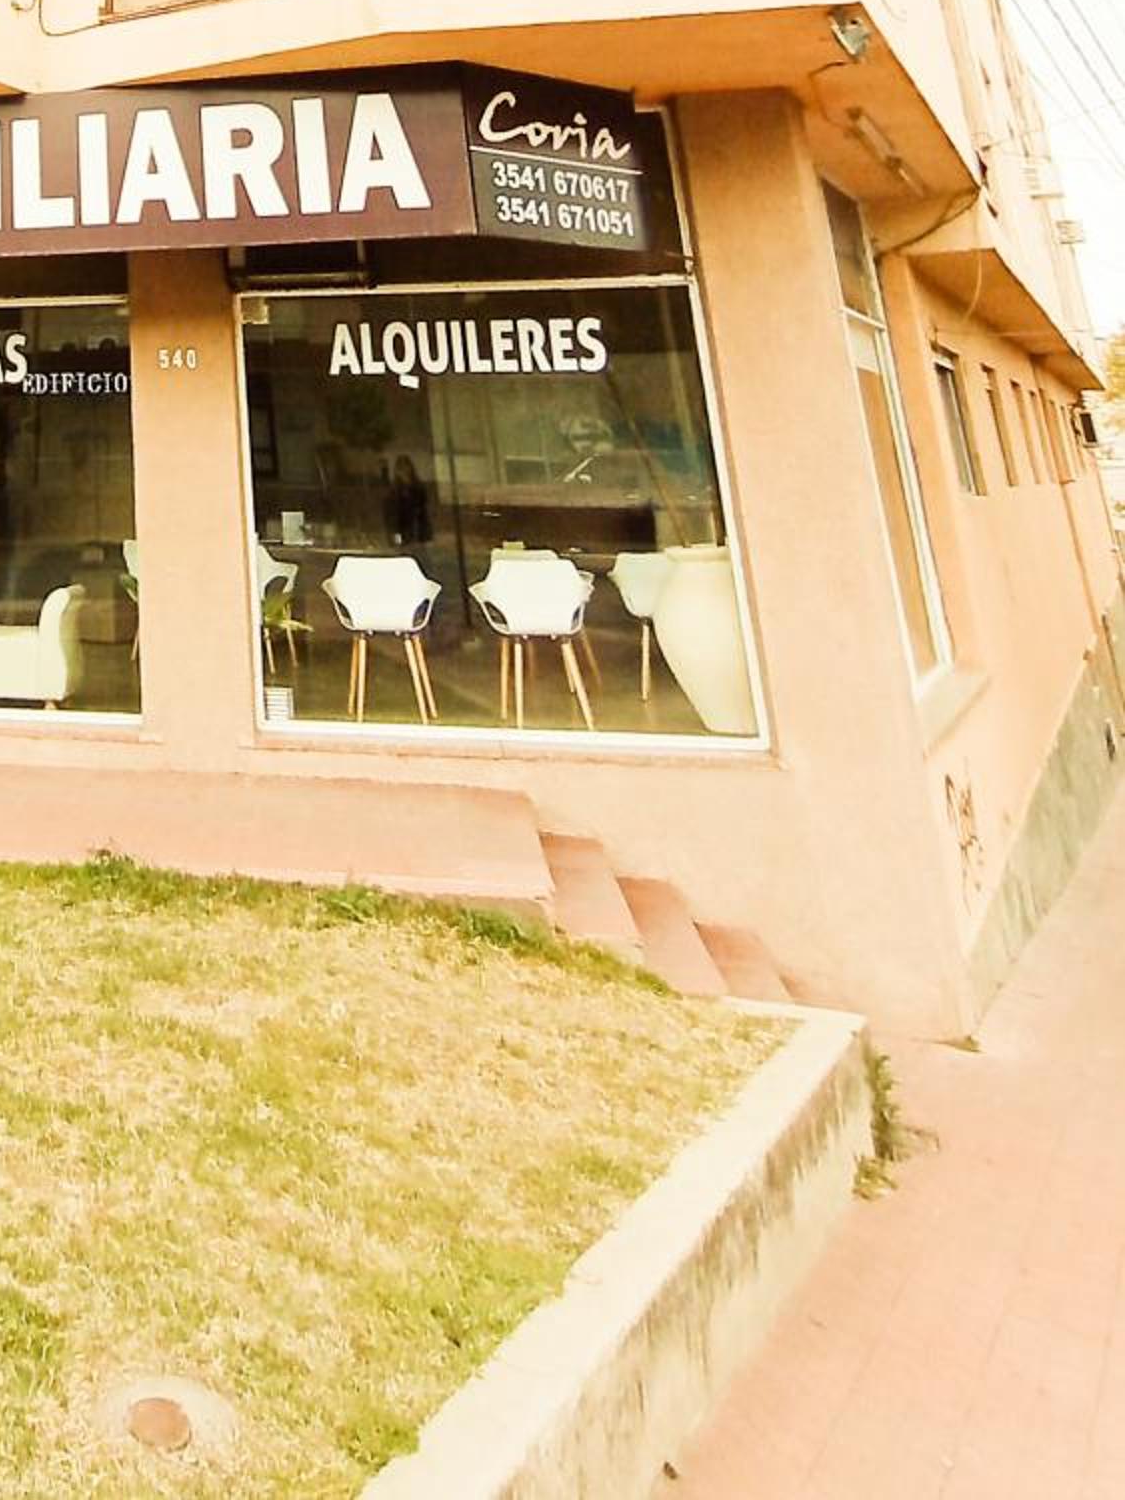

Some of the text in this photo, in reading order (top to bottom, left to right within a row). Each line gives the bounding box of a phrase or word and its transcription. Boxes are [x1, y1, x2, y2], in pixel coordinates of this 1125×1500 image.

[479, 91, 631, 160] Coria
[492, 161, 630, 204] 3541 670617
[496, 195, 635, 237] 3541 671051
[158, 348, 197, 370] 540
[329, 317, 607, 389] ALQUILERES
[23, 372, 127, 395] EDIFICIO
